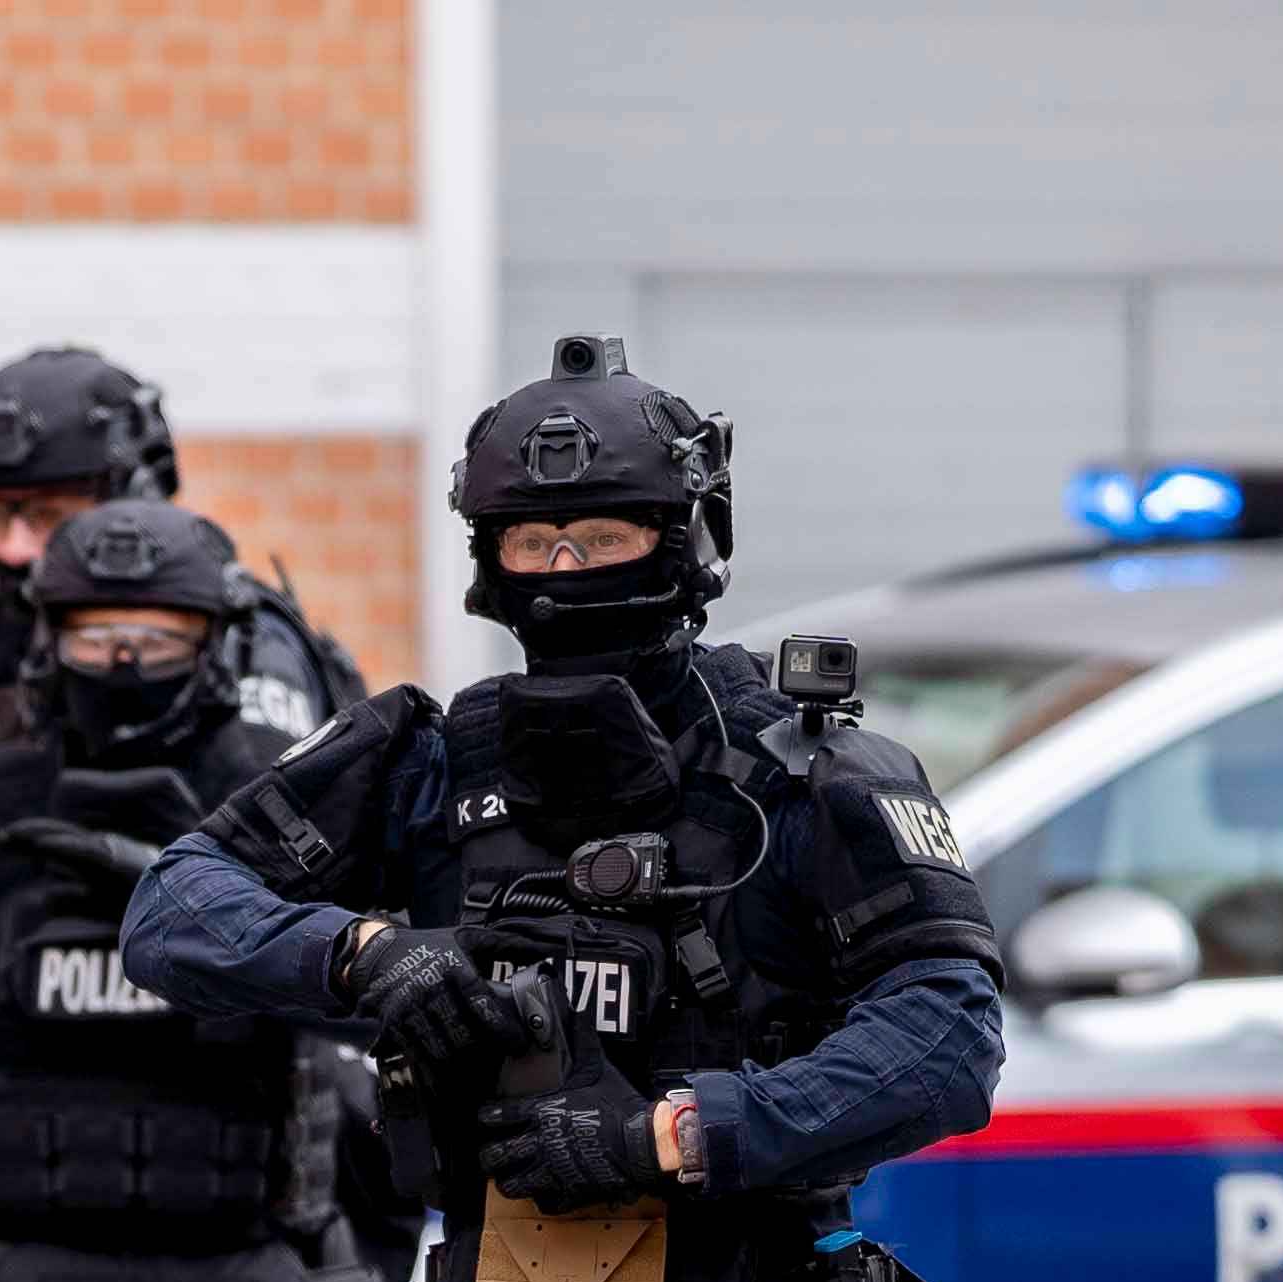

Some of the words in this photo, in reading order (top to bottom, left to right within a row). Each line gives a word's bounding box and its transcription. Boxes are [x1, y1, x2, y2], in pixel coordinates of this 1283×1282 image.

[238, 677, 316, 740] EGA
[458, 799, 472, 826] K
[37, 948, 169, 1014] POLI
